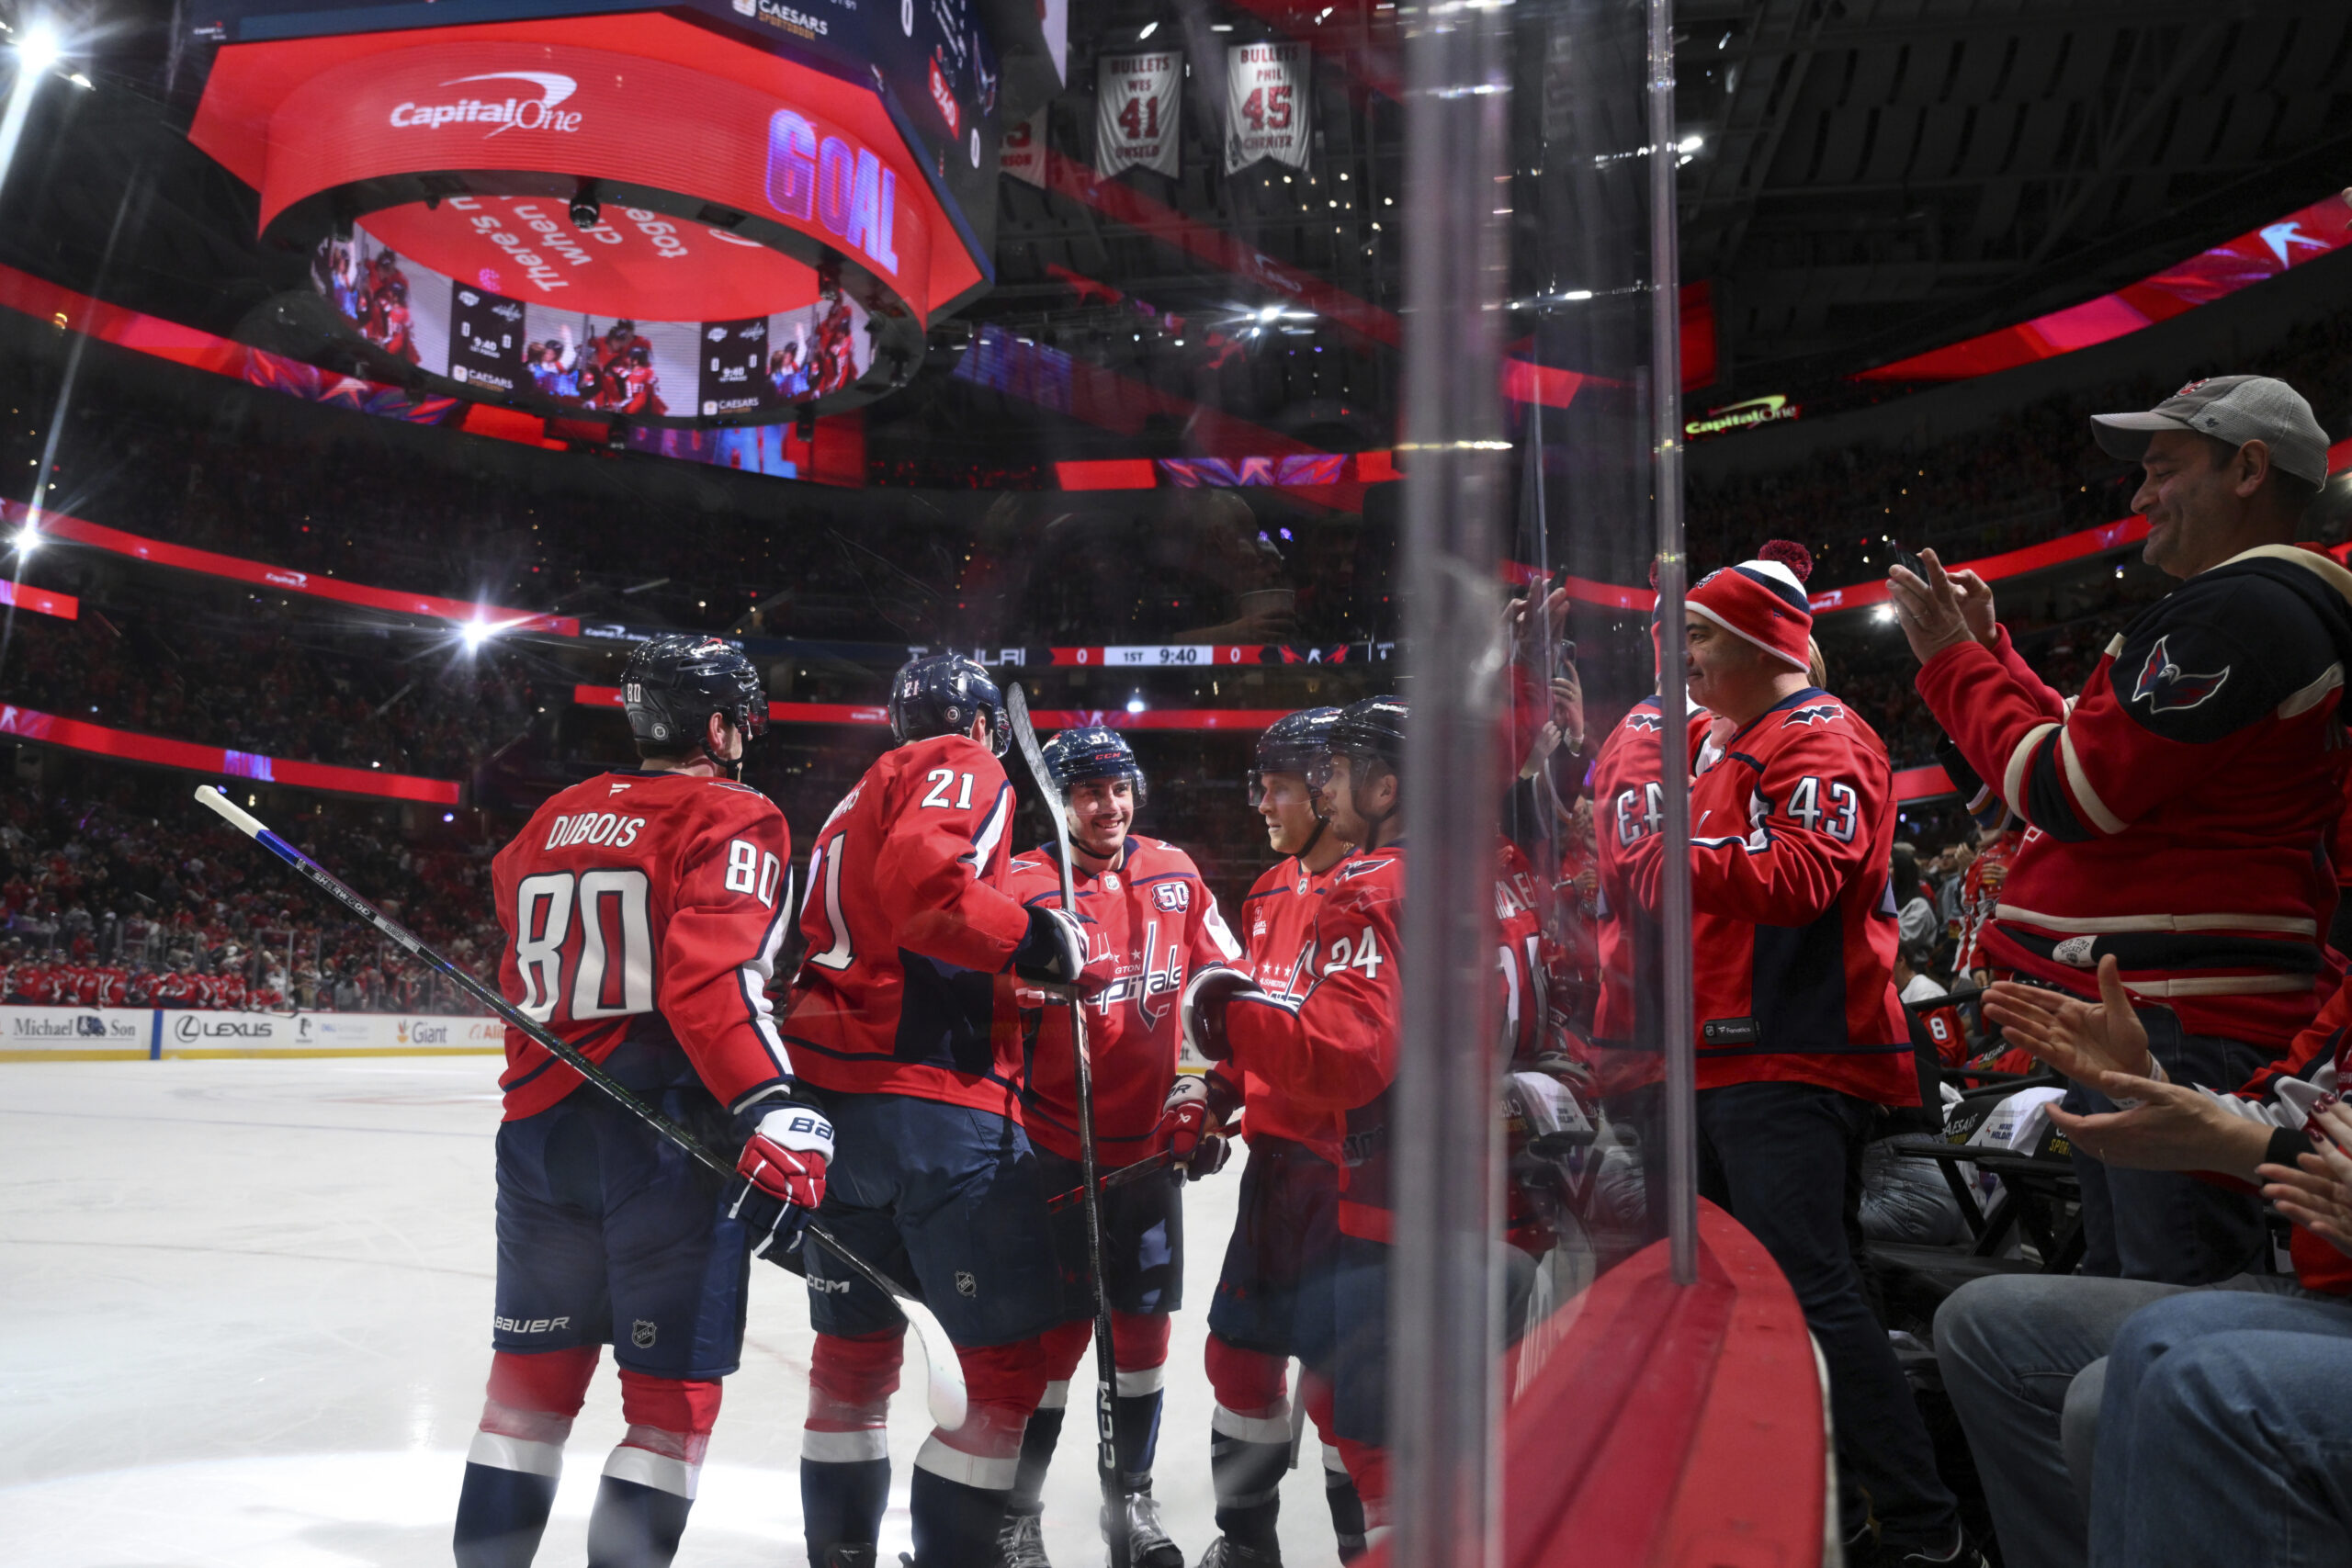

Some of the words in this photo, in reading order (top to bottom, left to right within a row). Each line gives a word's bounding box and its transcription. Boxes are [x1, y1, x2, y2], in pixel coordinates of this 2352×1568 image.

[1111, 56, 1170, 74] BULLETS
[1240, 46, 1298, 63] BULLETS
[1128, 79, 1152, 92] WES
[1256, 69, 1283, 82] PHIL
[1118, 97, 1159, 139] 41
[1241, 85, 1293, 130] 45
[765, 108, 899, 276] GOAL
[514, 205, 593, 266] when
[470, 216, 569, 292] There's
[1077, 649, 1088, 664] 0
[1124, 653, 1144, 662] 1ST
[1159, 649, 1197, 664] 9:40
[1229, 648, 1241, 663] 0
[628, 683, 640, 702] 80
[903, 680, 920, 698] 21
[1095, 752, 1121, 761] CCM
[920, 768, 976, 811] 21
[1787, 776, 1858, 842] 43
[545, 812, 646, 851] DUBOIS
[723, 839, 781, 909] 80
[1156, 883, 1189, 909] 50
[385, 924, 405, 942] DUBOIS
[515, 867, 656, 1022] 80
[1323, 926, 1384, 979] 24
[2058, 939, 2074, 950] OLD
[2075, 938, 2090, 951] TIME
[2062, 947, 2084, 955] HOCKEY
[13, 1018, 73, 1036] Michael
[110, 1019, 136, 1036] Son
[204, 1023, 273, 1037] LEXUS
[413, 1021, 447, 1043] Giant
[1725, 1026, 1751, 1034] Fanatics
[1929, 1017, 1948, 1041] 8
[807, 1273, 850, 1293] CCM
[1098, 1381, 1115, 1470] CCM
